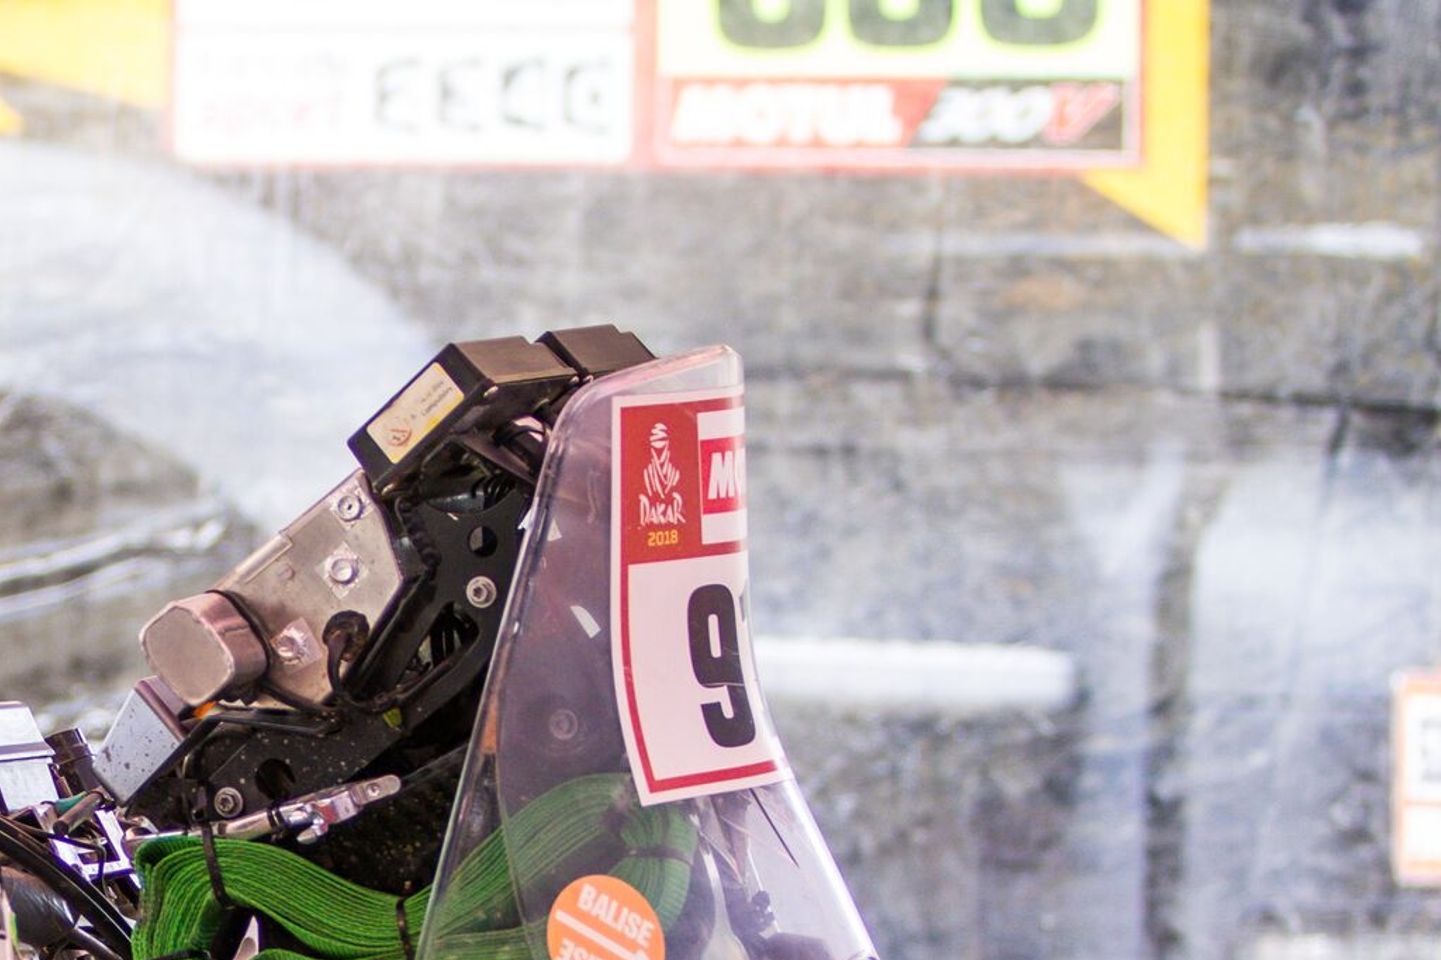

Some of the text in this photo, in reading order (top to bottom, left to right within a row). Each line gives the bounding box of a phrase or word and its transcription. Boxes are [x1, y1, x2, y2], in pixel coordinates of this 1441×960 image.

[638, 491, 686, 527] DAKAR
[647, 529, 679, 547] 2018
[687, 582, 756, 749] 9
[577, 883, 656, 948] BALISE
